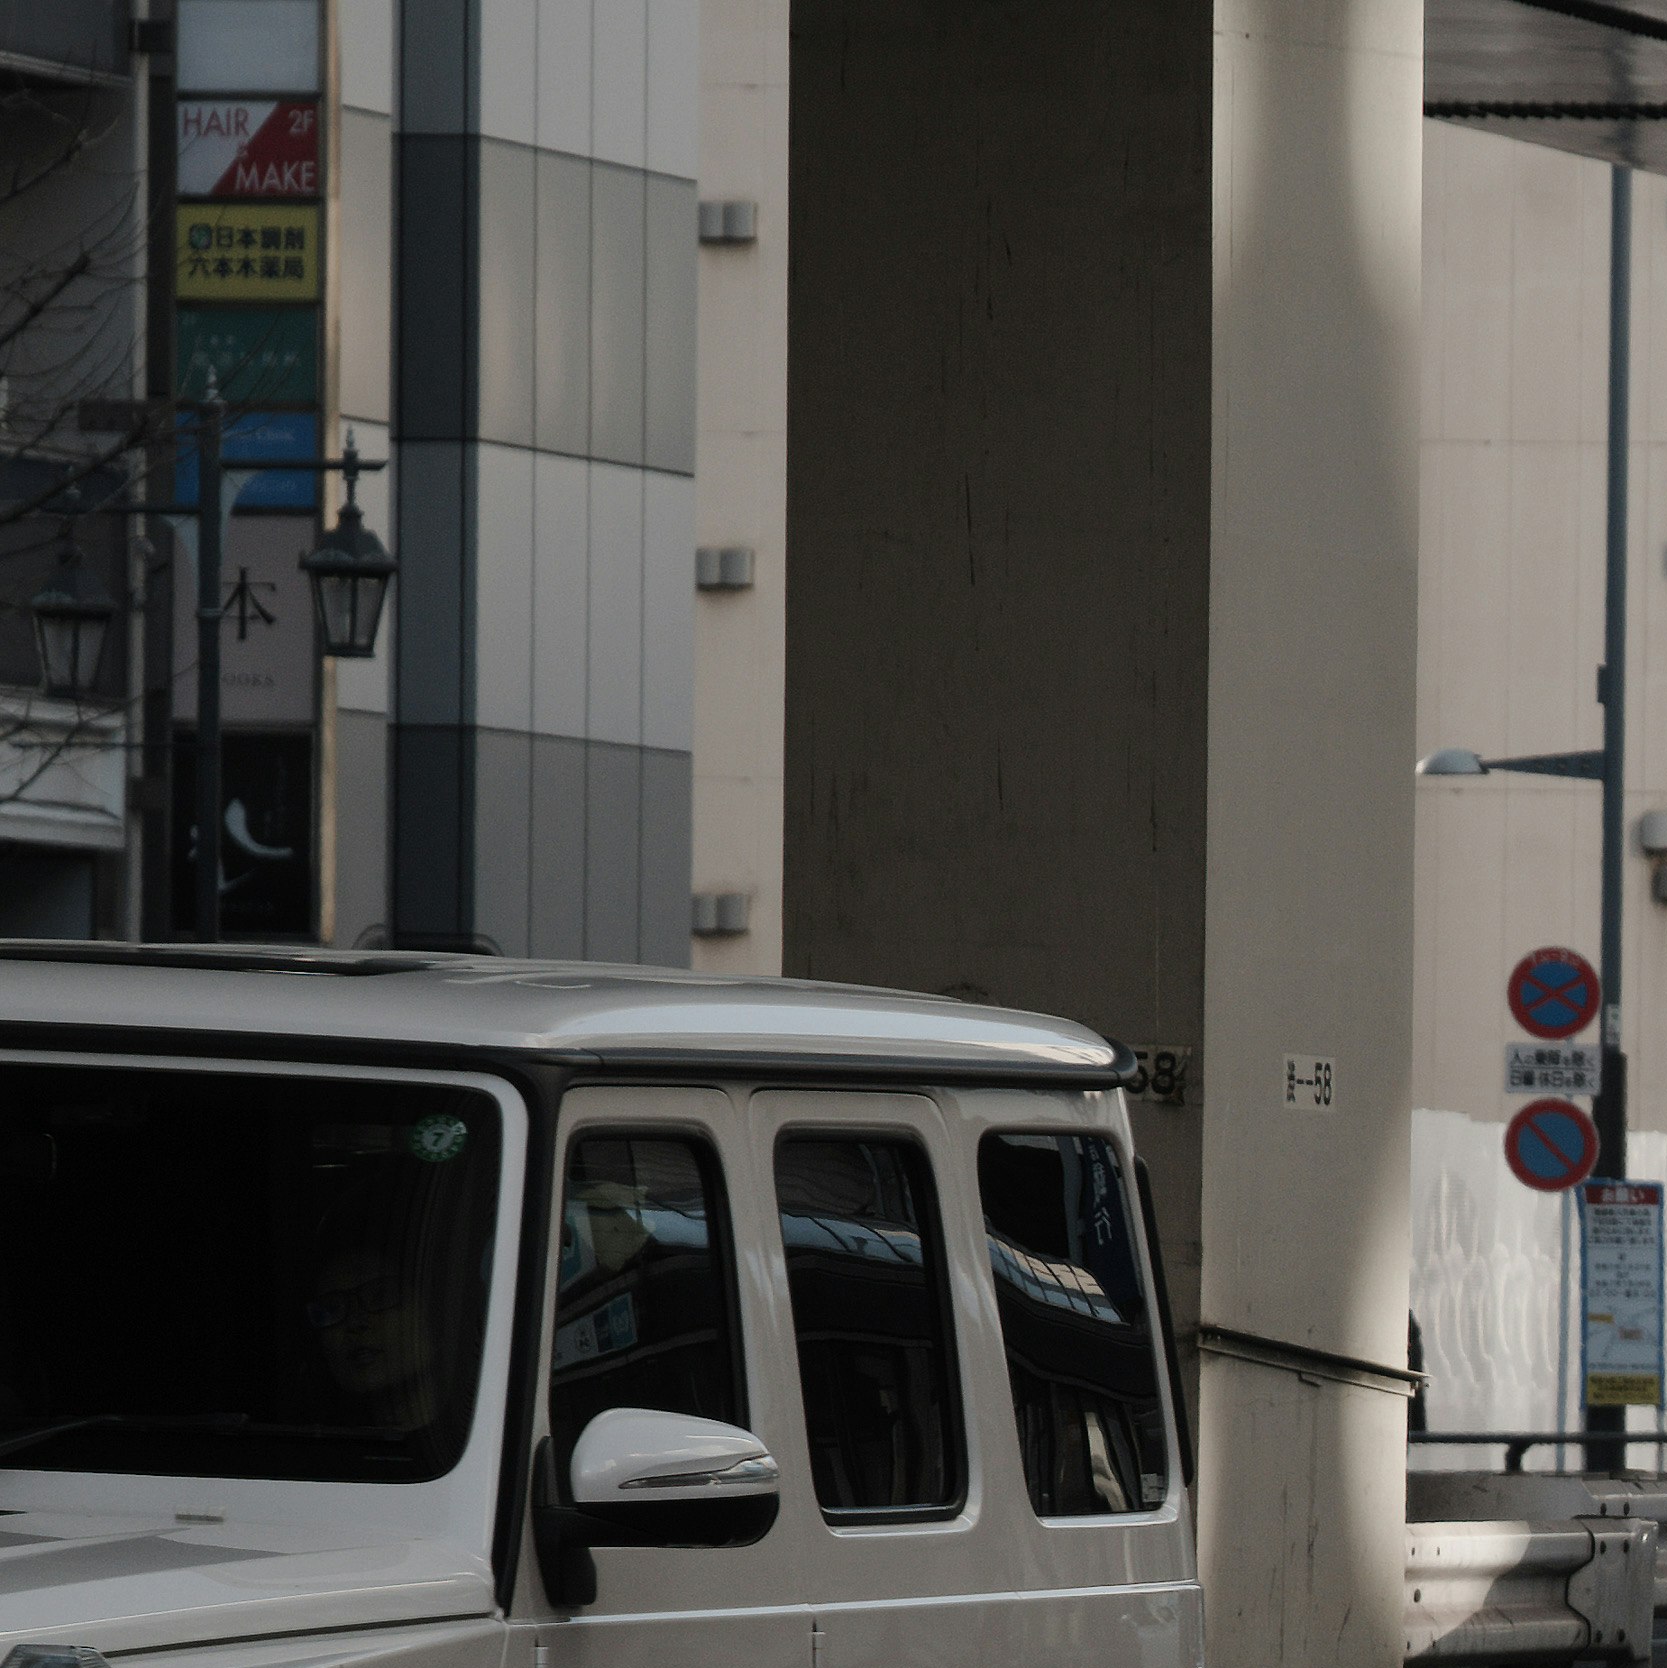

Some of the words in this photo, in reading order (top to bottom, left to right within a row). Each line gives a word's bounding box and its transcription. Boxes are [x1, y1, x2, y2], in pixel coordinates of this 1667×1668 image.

[183, 107, 250, 137] HAIR
[288, 109, 315, 136] 2F
[234, 160, 316, 192] MAKE
[188, 255, 305, 279] 六本木薬局
[220, 567, 277, 641] 本
